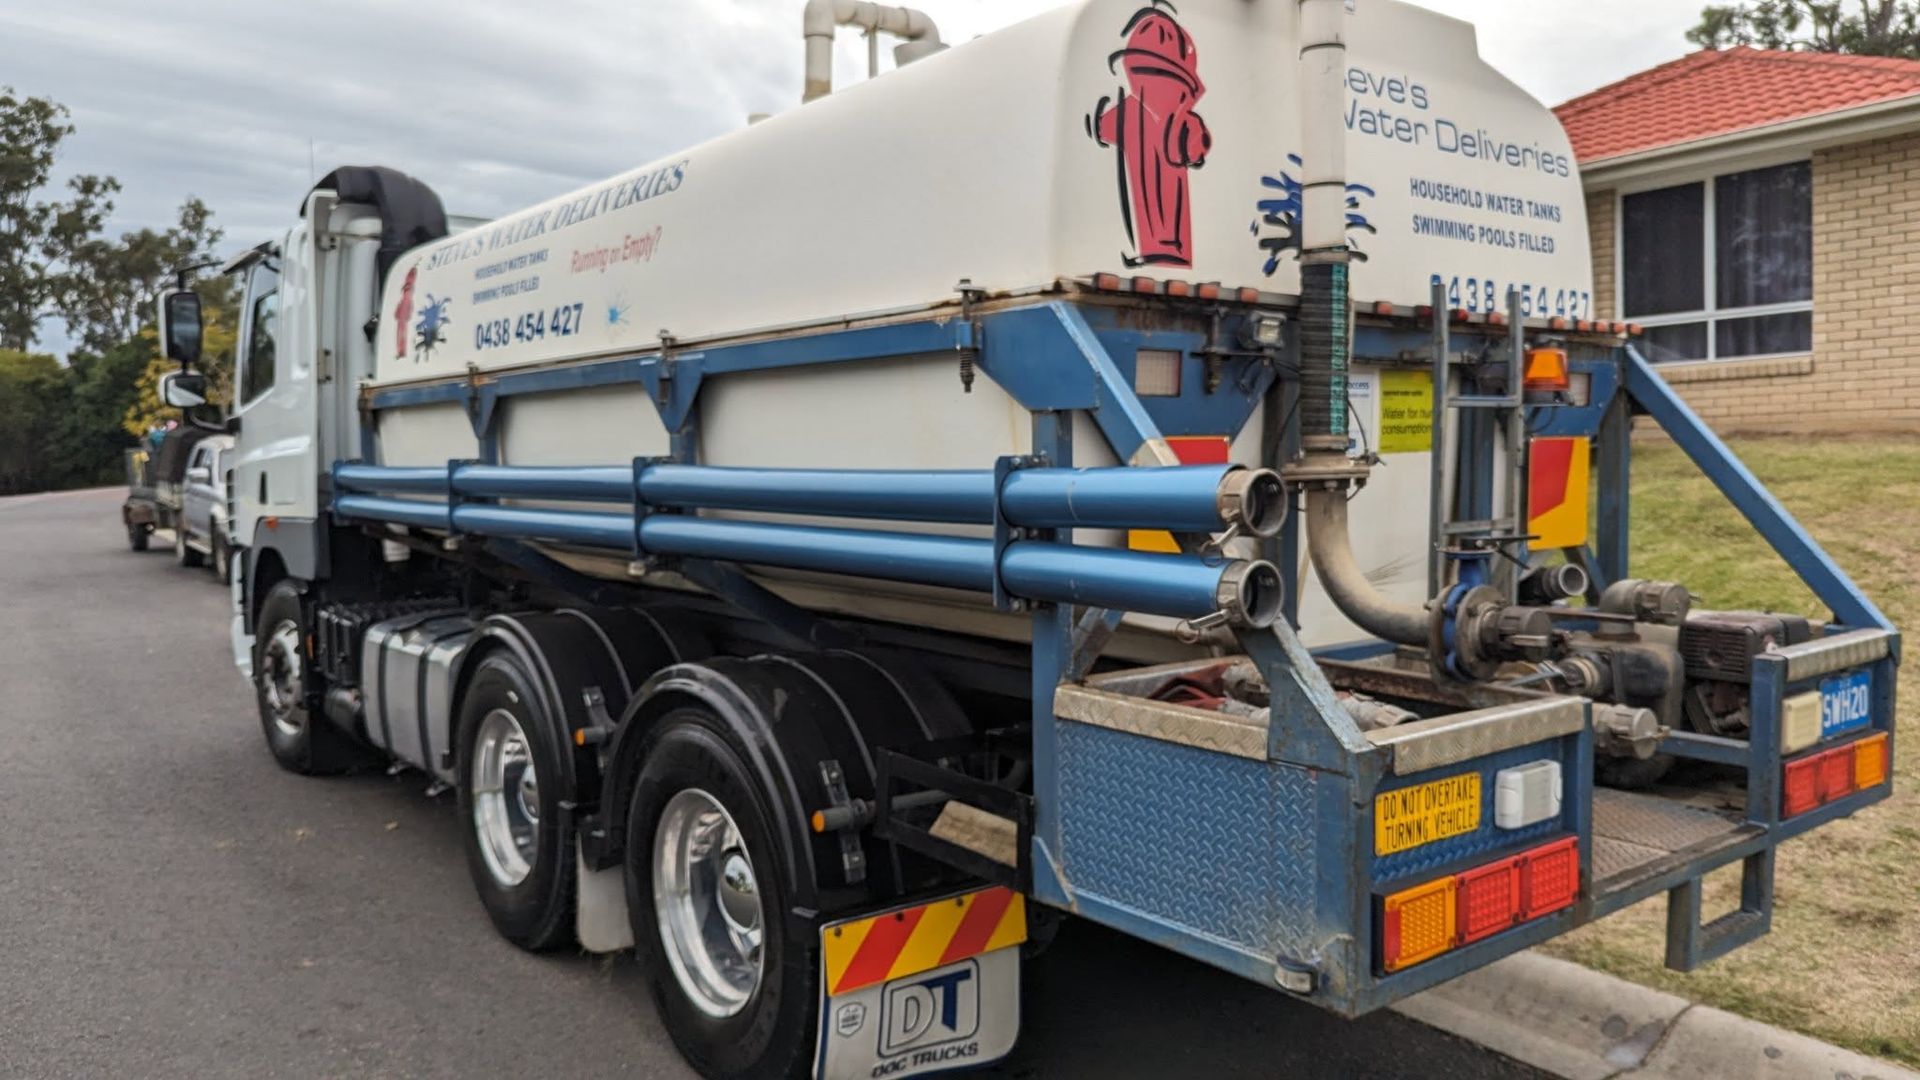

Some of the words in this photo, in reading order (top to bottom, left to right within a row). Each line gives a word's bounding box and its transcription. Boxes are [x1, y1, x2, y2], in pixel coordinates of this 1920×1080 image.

[1345, 67, 1429, 110] eve's
[1435, 117, 1569, 177] Deliveries
[488, 211, 551, 250] WATER
[551, 159, 689, 231] DELIVERIES
[1410, 178, 1483, 209] HOUSEHOLD
[1485, 192, 1525, 217] WATER
[1526, 200, 1562, 223] TANKS
[571, 247, 609, 274] Running
[622, 225, 662, 263] Empty?
[1412, 213, 1476, 243] SWIMMING
[1478, 225, 1517, 249] POOLS
[1518, 232, 1555, 254] FILLED
[508, 254, 529, 272] WATER
[529, 247, 549, 266] TANKS
[501, 281, 520, 298] POOLS
[520, 276, 540, 293] FILLED
[1430, 273, 1496, 315] 438
[476, 318, 510, 350] 0438
[515, 310, 545, 343] 454
[550, 302, 584, 337] 427
[1383, 407, 1405, 419] Water
[1407, 407, 1418, 419] for
[1383, 793, 1396, 820] DO
[1401, 786, 1422, 816] NOT
[1425, 775, 1474, 811] OVERTAKE
[1384, 815, 1428, 849] TURNING
[1434, 803, 1474, 836] VEHICLE
[886, 967, 972, 1051] DT
[871, 1057, 907, 1078] DOC
[912, 1042, 979, 1067] TRUCKS
